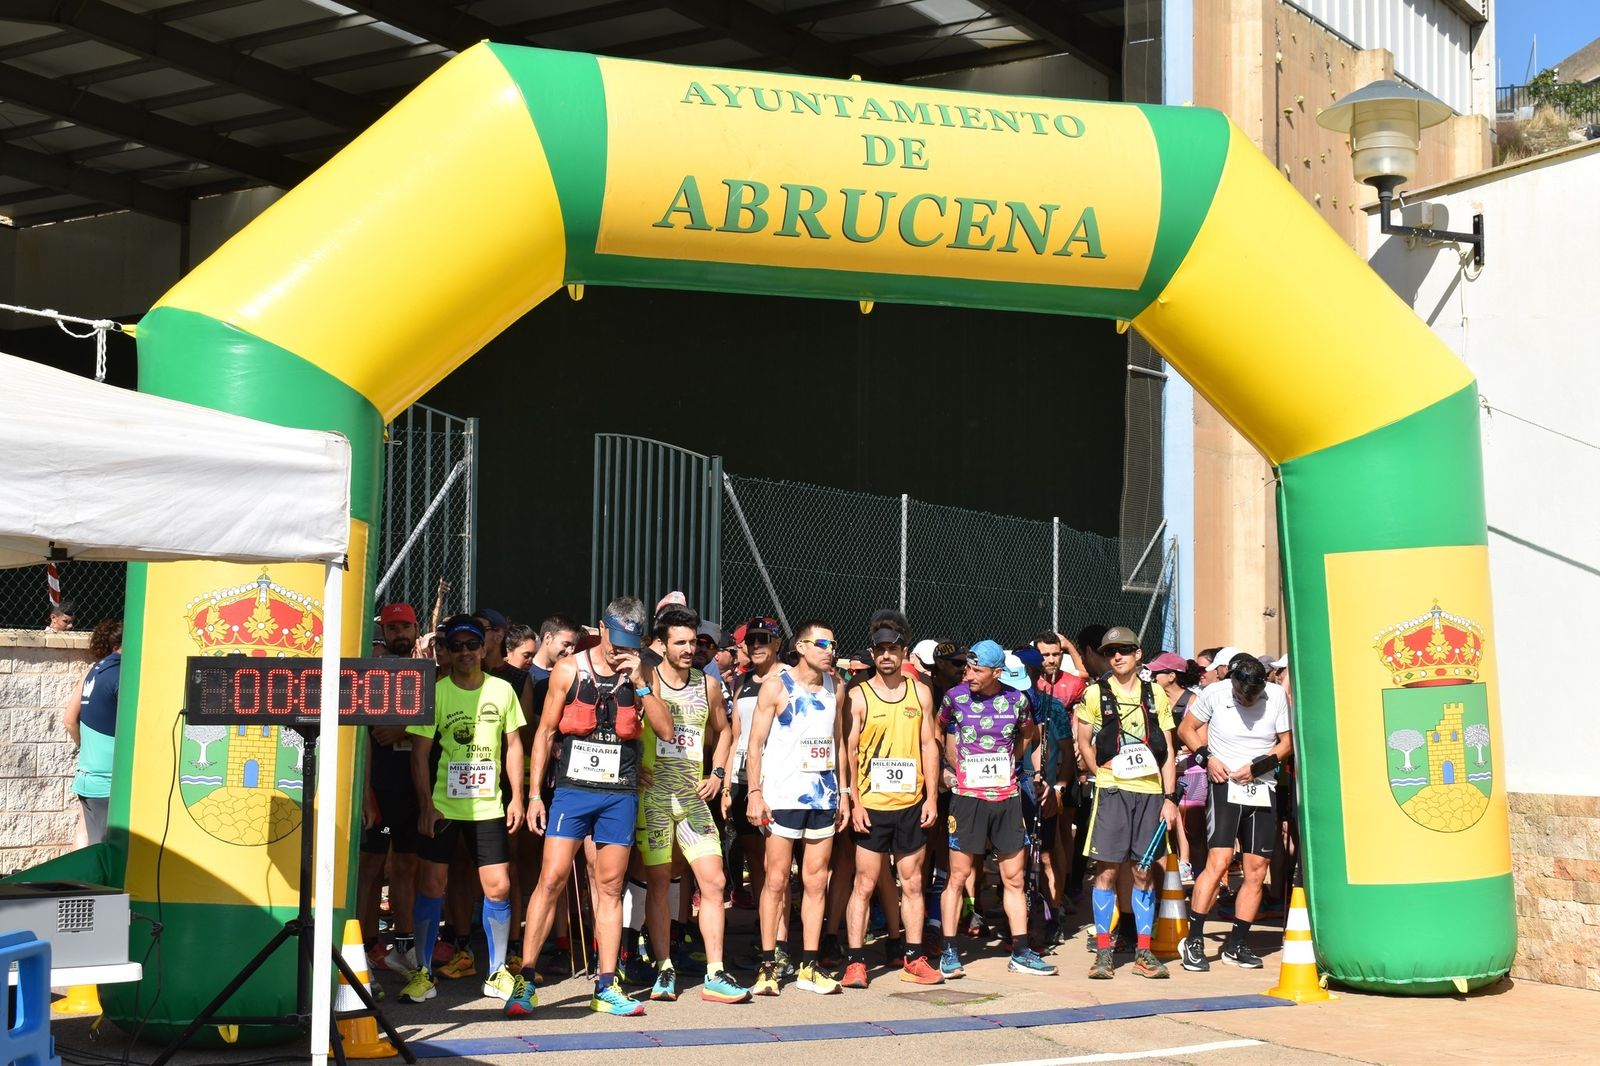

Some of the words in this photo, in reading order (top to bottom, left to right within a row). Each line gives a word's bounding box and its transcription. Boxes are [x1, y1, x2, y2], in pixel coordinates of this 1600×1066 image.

[680, 80, 1086, 139] AYUNTAMIENTO
[861, 133, 929, 171] DE
[652, 175, 1108, 259] ABRUCENA
[573, 744, 619, 755] MILENARIA
[811, 746, 830, 759] 596
[590, 755, 600, 768] 9
[967, 755, 1008, 763] MILENARIA
[1126, 753, 1144, 766] 16
[886, 769, 904, 780] 30
[981, 764, 998, 775] 41
[458, 773, 487, 785] 515
